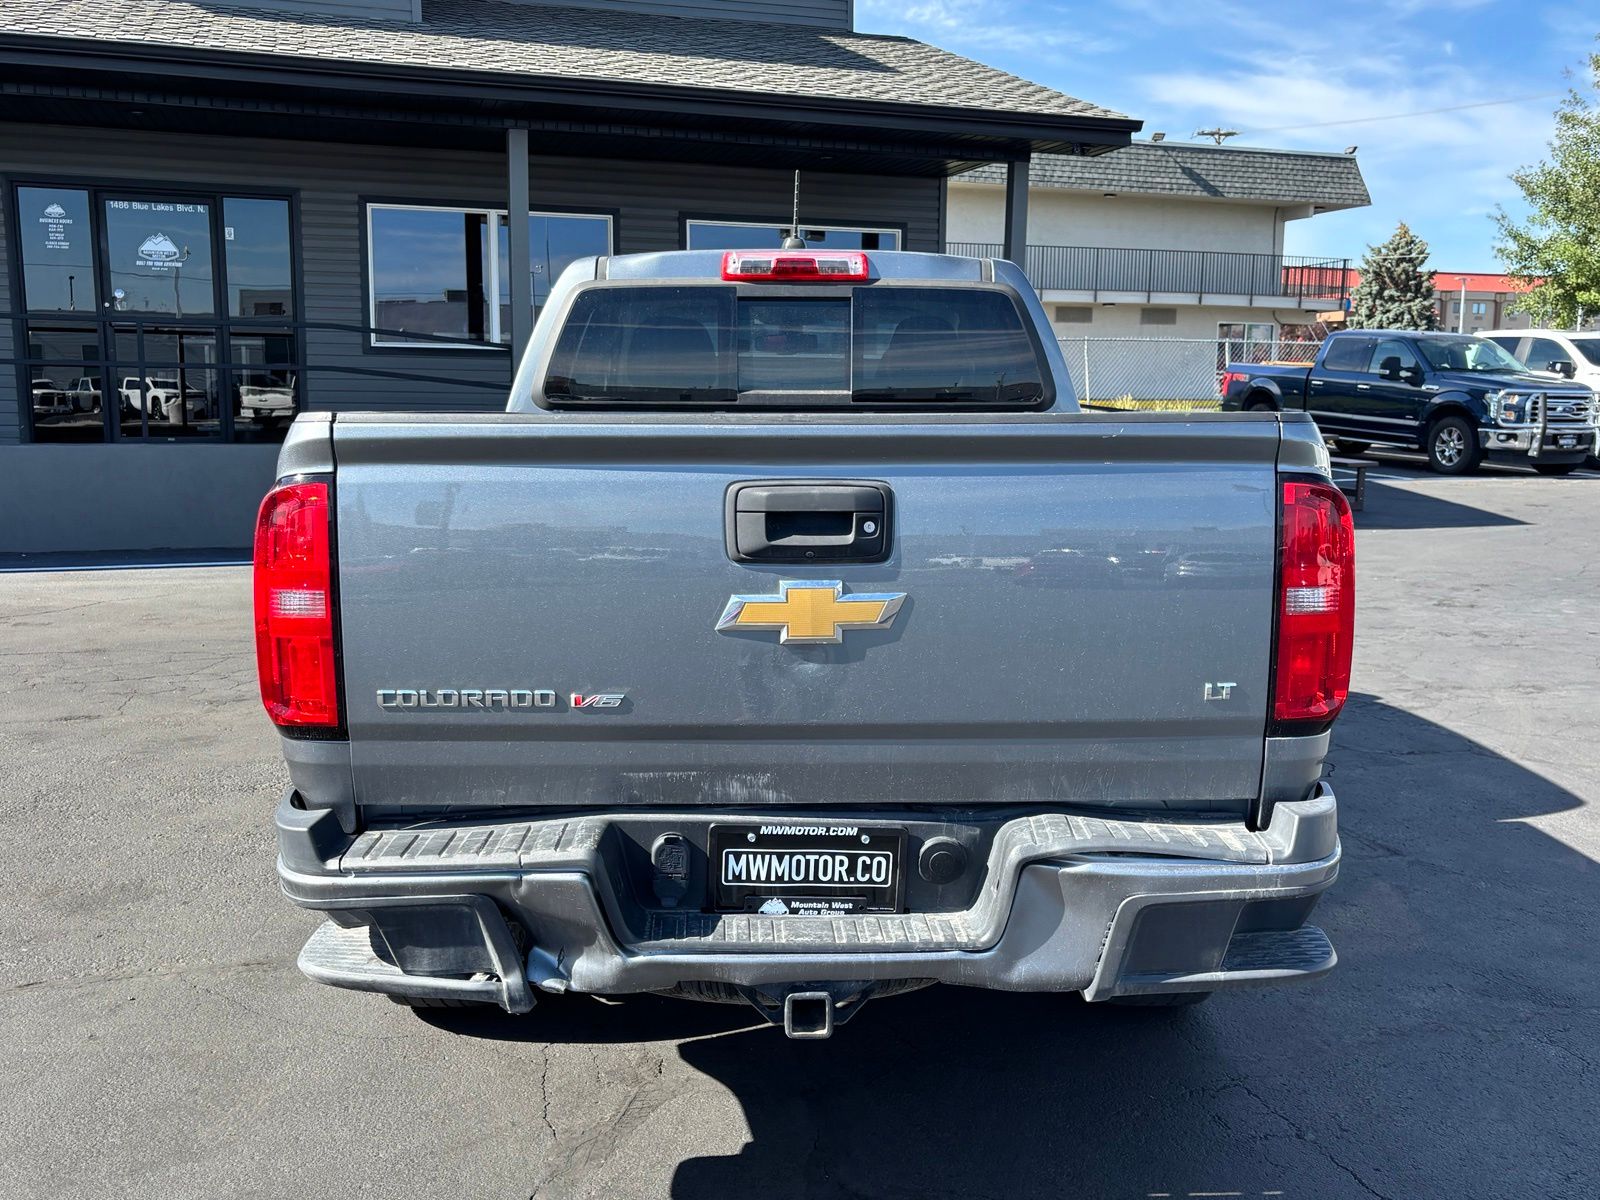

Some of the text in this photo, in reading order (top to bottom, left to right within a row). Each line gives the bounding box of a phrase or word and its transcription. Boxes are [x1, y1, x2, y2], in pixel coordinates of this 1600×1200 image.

[110, 200, 206, 213] 1486 Blue Lakes Blvd. N.
[1204, 682, 1237, 701] LT
[376, 689, 625, 708] COLORADO V6
[759, 825, 859, 837] MWMOTOR.COM
[727, 853, 887, 883] MWMOTOR.CO
[790, 900, 854, 909] Mountain West
[798, 908, 846, 916] Auto Group
